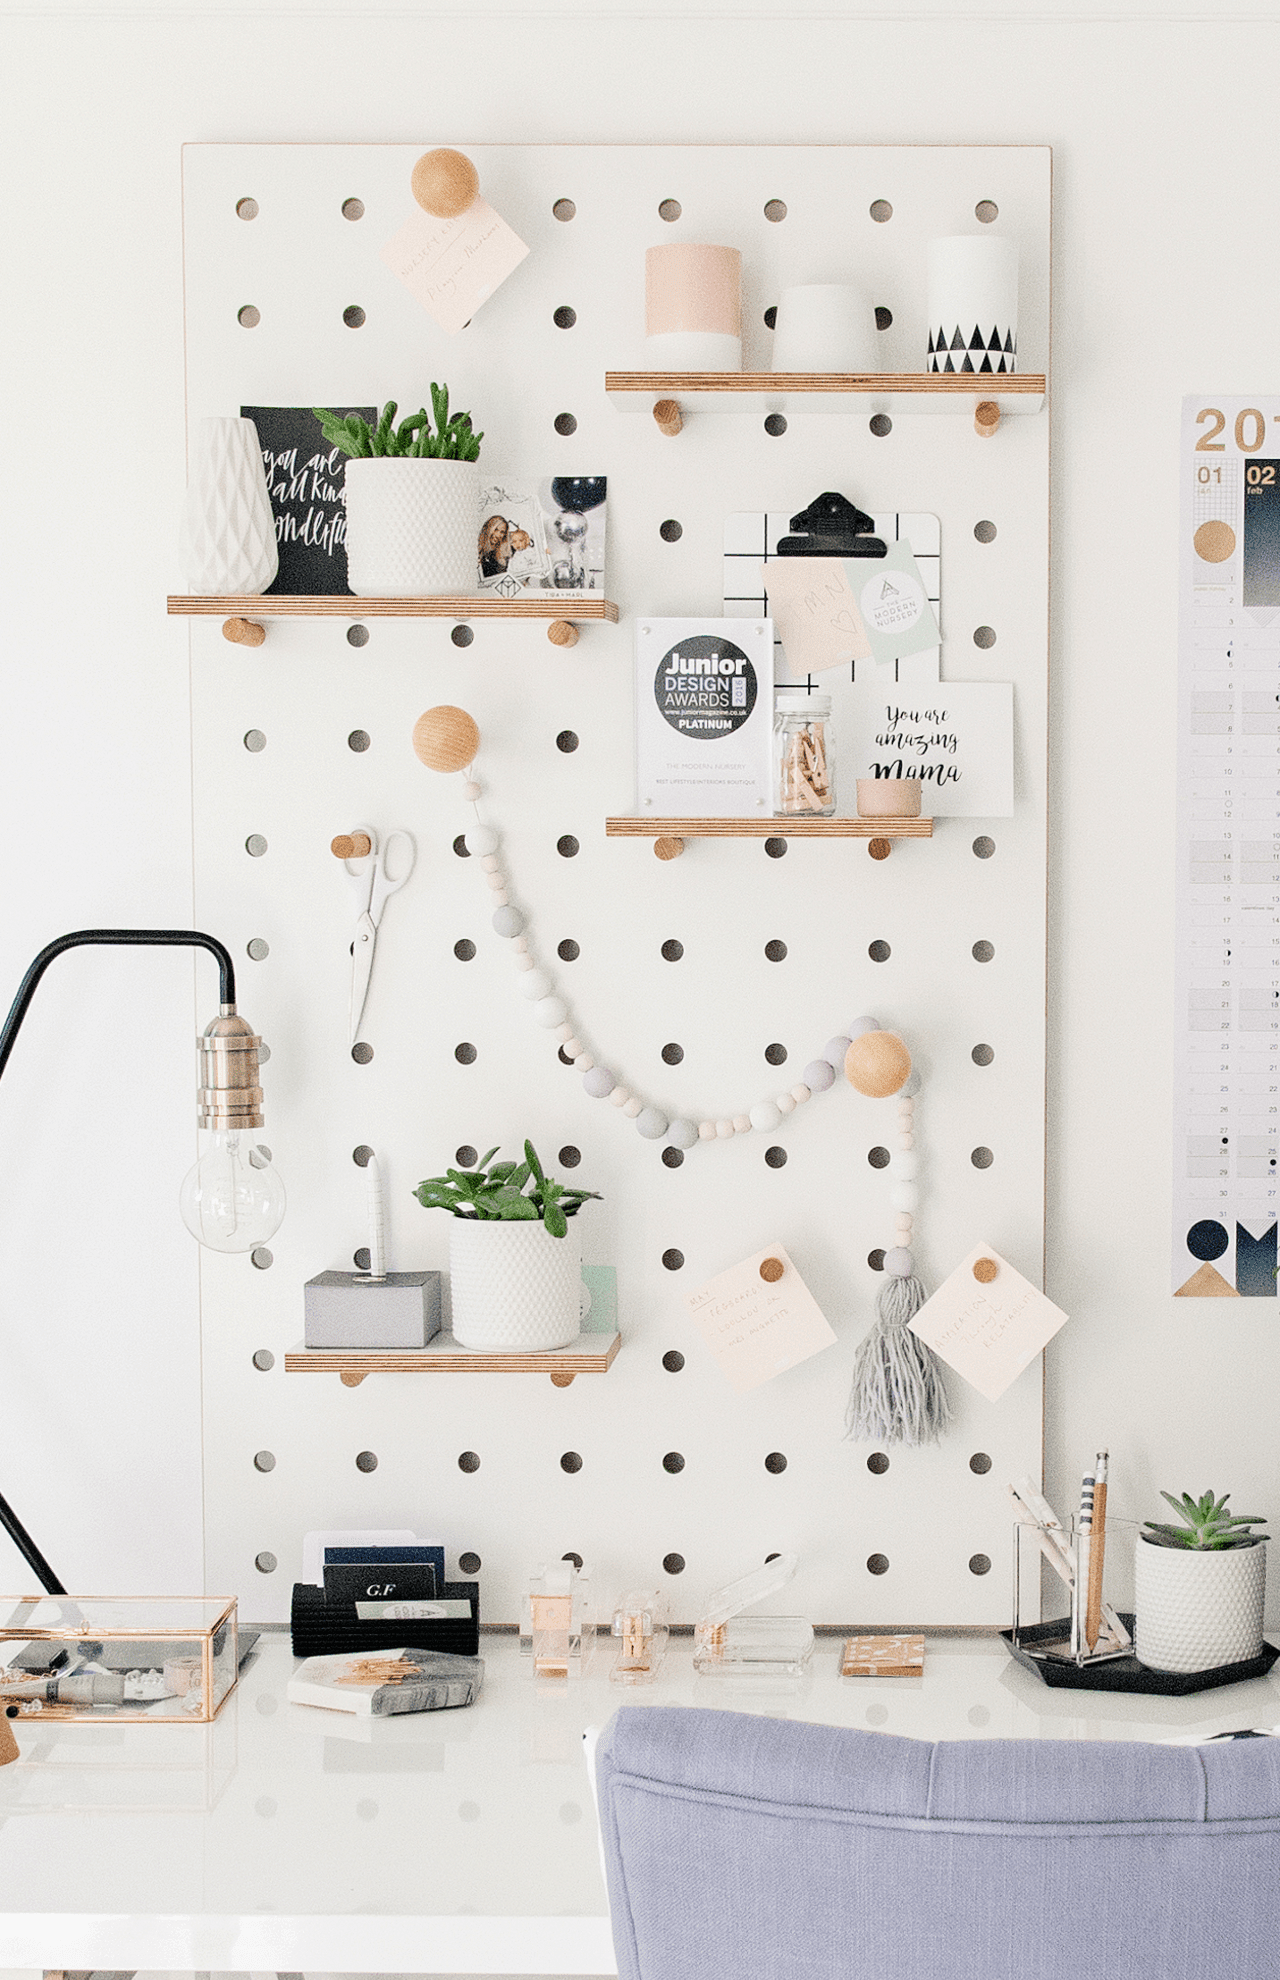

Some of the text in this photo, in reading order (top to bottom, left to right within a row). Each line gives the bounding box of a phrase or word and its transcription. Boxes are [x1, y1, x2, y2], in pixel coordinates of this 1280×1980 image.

[307, 447, 342, 476] are
[1197, 466, 1222, 484] 01
[1246, 465, 1276, 485] 02
[1247, 486, 1263, 495] feb
[874, 601, 916, 619] MODERN
[877, 608, 918, 627] NURSERY
[665, 653, 747, 675] Junior
[665, 677, 744, 704] DESIGN 2016
[665, 693, 729, 707] AWARDS
[679, 719, 733, 729] PLATINUM
[886, 705, 951, 732] You are
[875, 732, 959, 756] amazing
